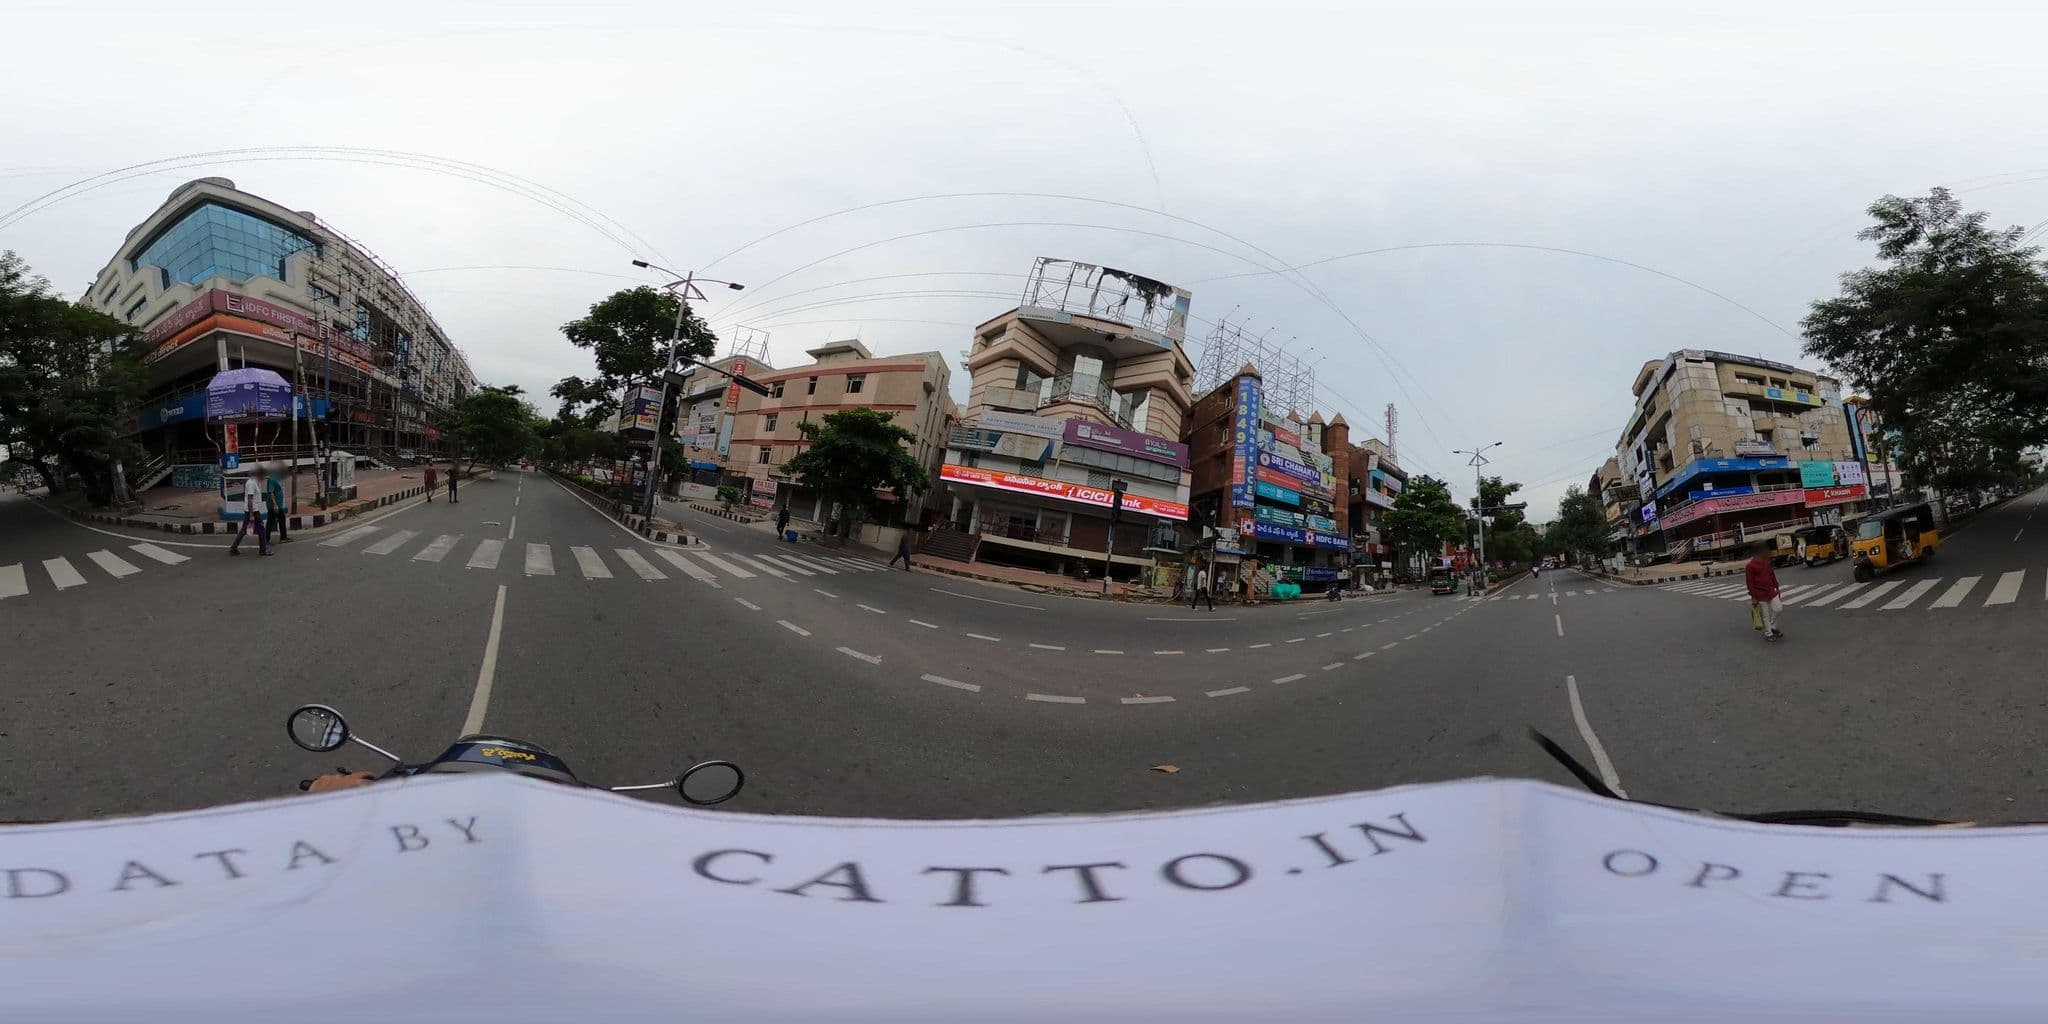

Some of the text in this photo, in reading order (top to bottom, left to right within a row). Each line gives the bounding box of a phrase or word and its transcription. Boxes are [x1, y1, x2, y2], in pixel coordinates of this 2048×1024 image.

[245, 303, 317, 334] IDFC FIRST Bank
[1236, 391, 1248, 443] 1849
[1271, 455, 1283, 466] SRI
[1284, 460, 1320, 480] CHANAKYA
[1076, 489, 1108, 502] ICICI
[1316, 535, 1349, 546] HDFC BANK
[3, 816, 483, 899] DATA BY
[691, 813, 1428, 907] CATTO.IN
[1602, 849, 1948, 903] OPEN
